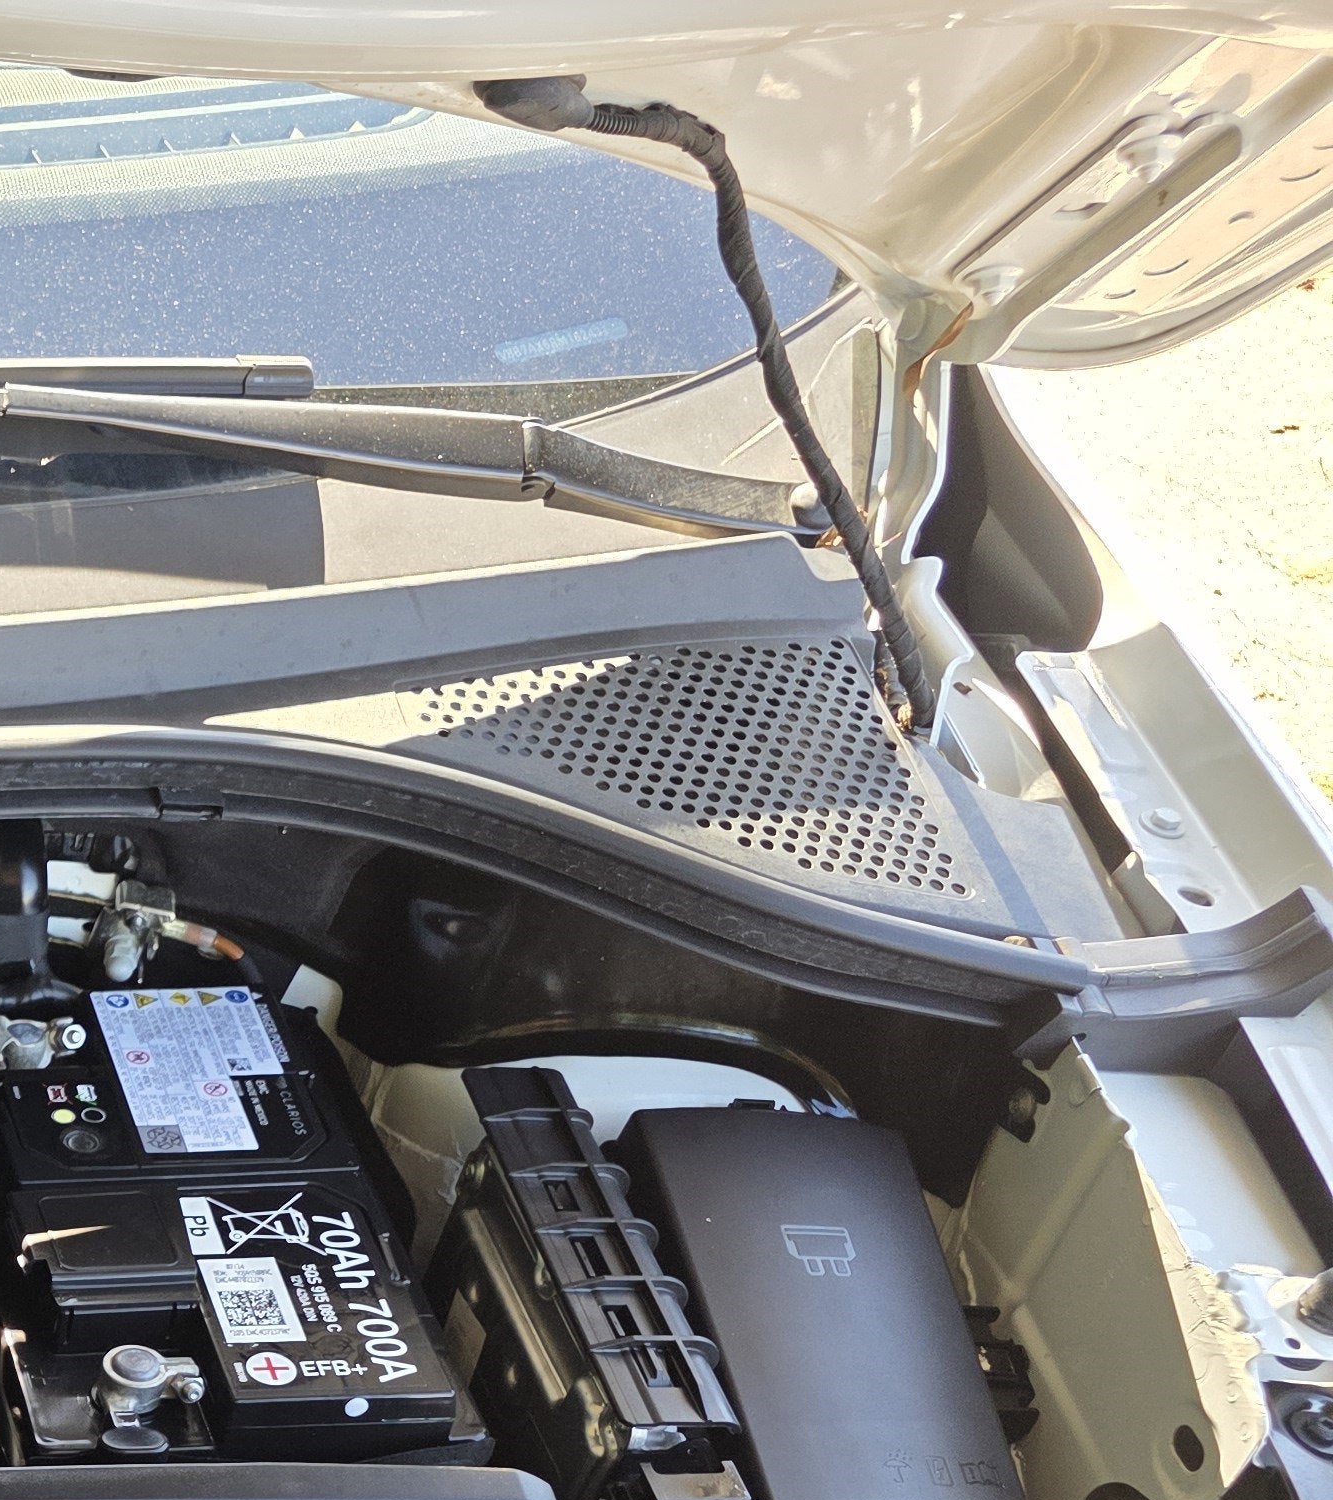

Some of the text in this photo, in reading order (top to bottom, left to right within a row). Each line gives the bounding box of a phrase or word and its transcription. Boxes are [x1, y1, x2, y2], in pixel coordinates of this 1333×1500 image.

[279, 1091, 308, 1137] CLARIOS
[183, 1215, 210, 1237] Pb
[312, 1211, 417, 1383] 70Ah 700A
[327, 1321, 342, 1333] C
[299, 1360, 368, 1377] EFB+
